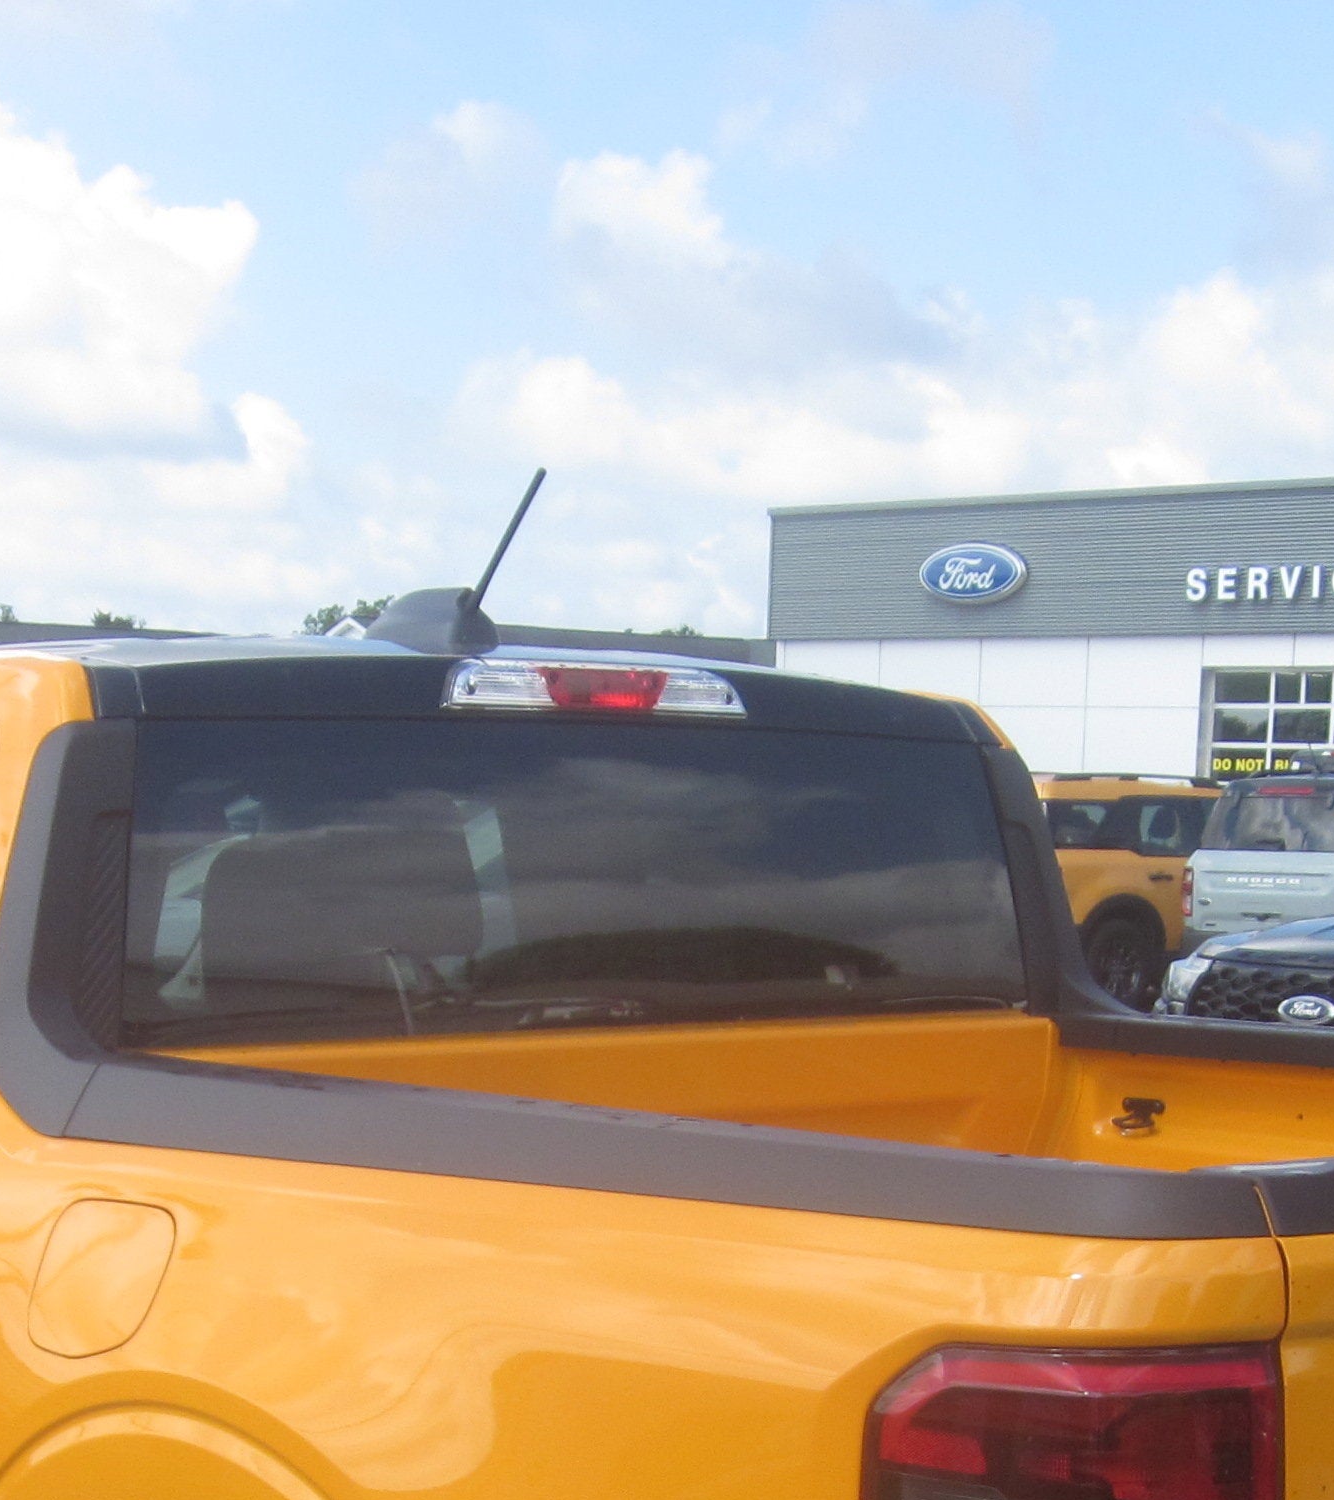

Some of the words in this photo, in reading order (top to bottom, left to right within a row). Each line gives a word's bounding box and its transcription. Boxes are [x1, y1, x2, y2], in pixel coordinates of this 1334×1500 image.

[939, 556, 996, 590] Ford
[1212, 758, 1232, 771] DO
[1235, 758, 1264, 771] NOT
